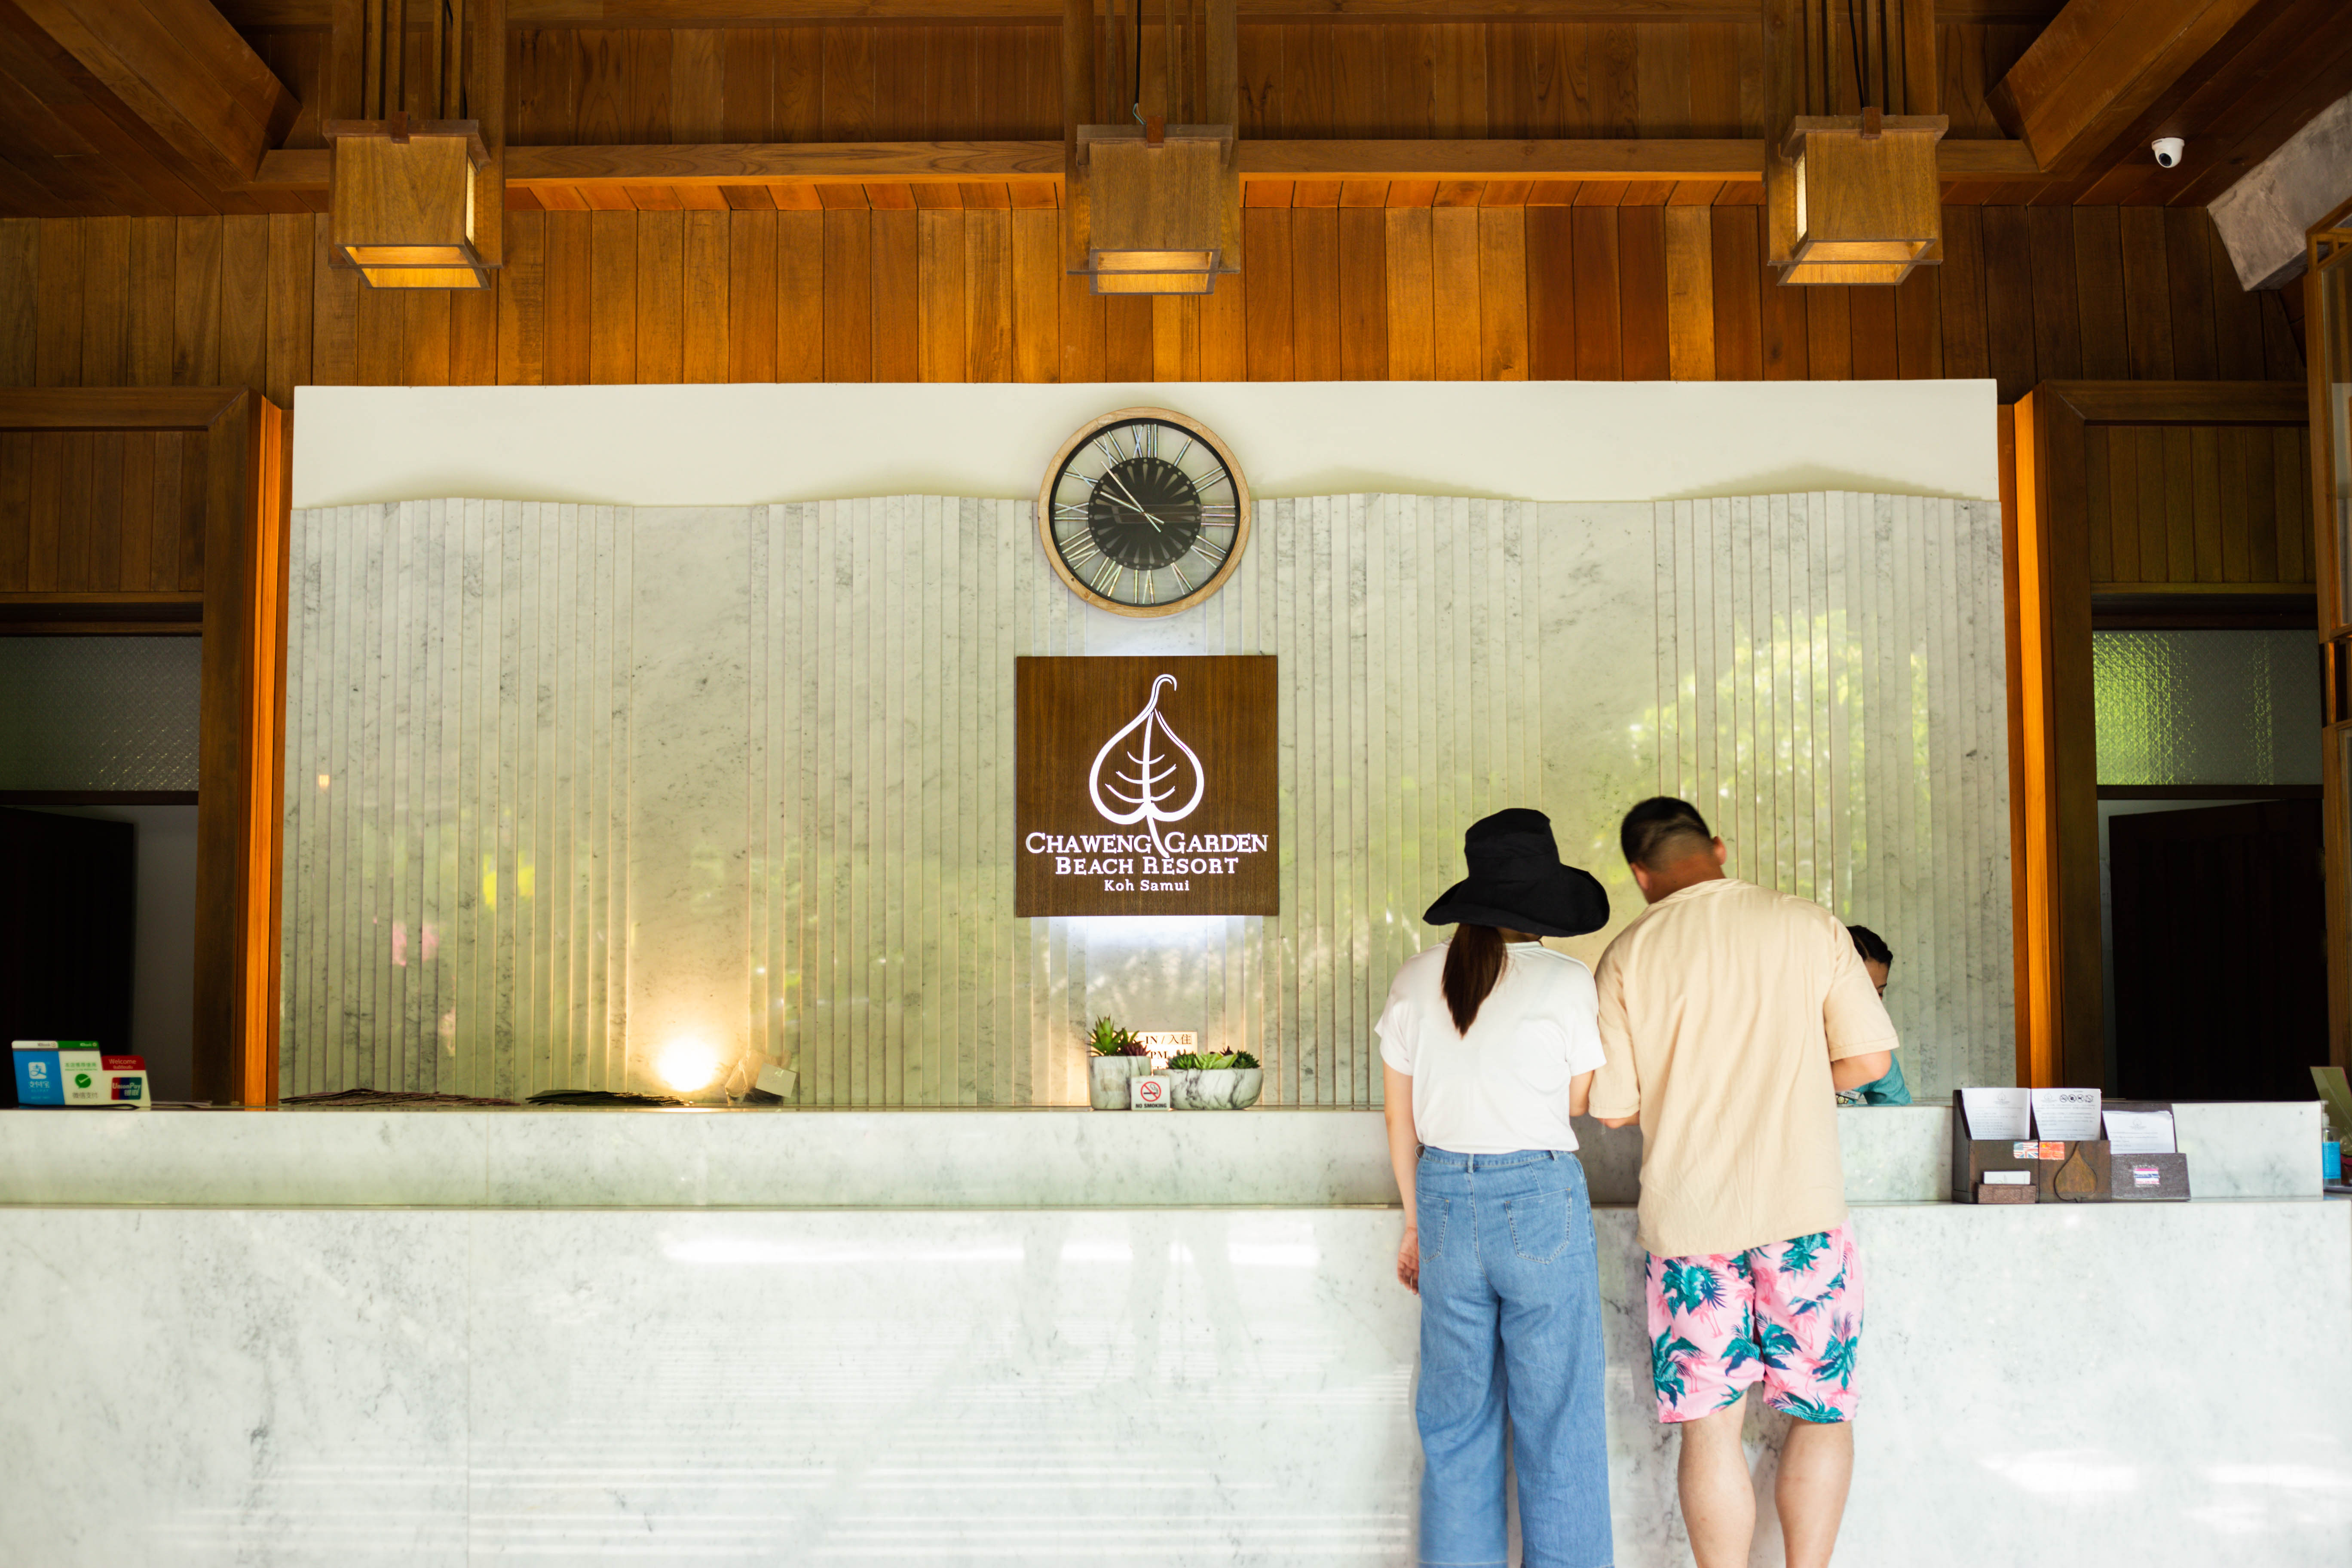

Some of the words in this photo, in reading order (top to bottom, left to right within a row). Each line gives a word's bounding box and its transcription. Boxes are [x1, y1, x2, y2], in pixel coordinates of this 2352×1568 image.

[1093, 431, 1127, 469] XI
[1132, 424, 1158, 458] XII
[1174, 437, 1193, 466] I
[1064, 463, 1099, 489] X
[1192, 466, 1227, 493] II
[1054, 502, 1089, 520] IX
[1200, 505, 1235, 526] III
[1059, 527, 1100, 570] VIII
[1191, 534, 1226, 568] IV
[1090, 557, 1122, 597] VII
[1134, 569, 1155, 604] VI
[1170, 562, 1193, 595] V
[1025, 832, 1151, 854] CHAWENG
[1164, 832, 1268, 854] GARDEN
[1055, 857, 1133, 876] BEACH
[1142, 857, 1238, 875] RESORT
[1104, 879, 1134, 891] Koh
[1140, 879, 1190, 891] Samui
[1168, 1034, 1191, 1044] 入住
